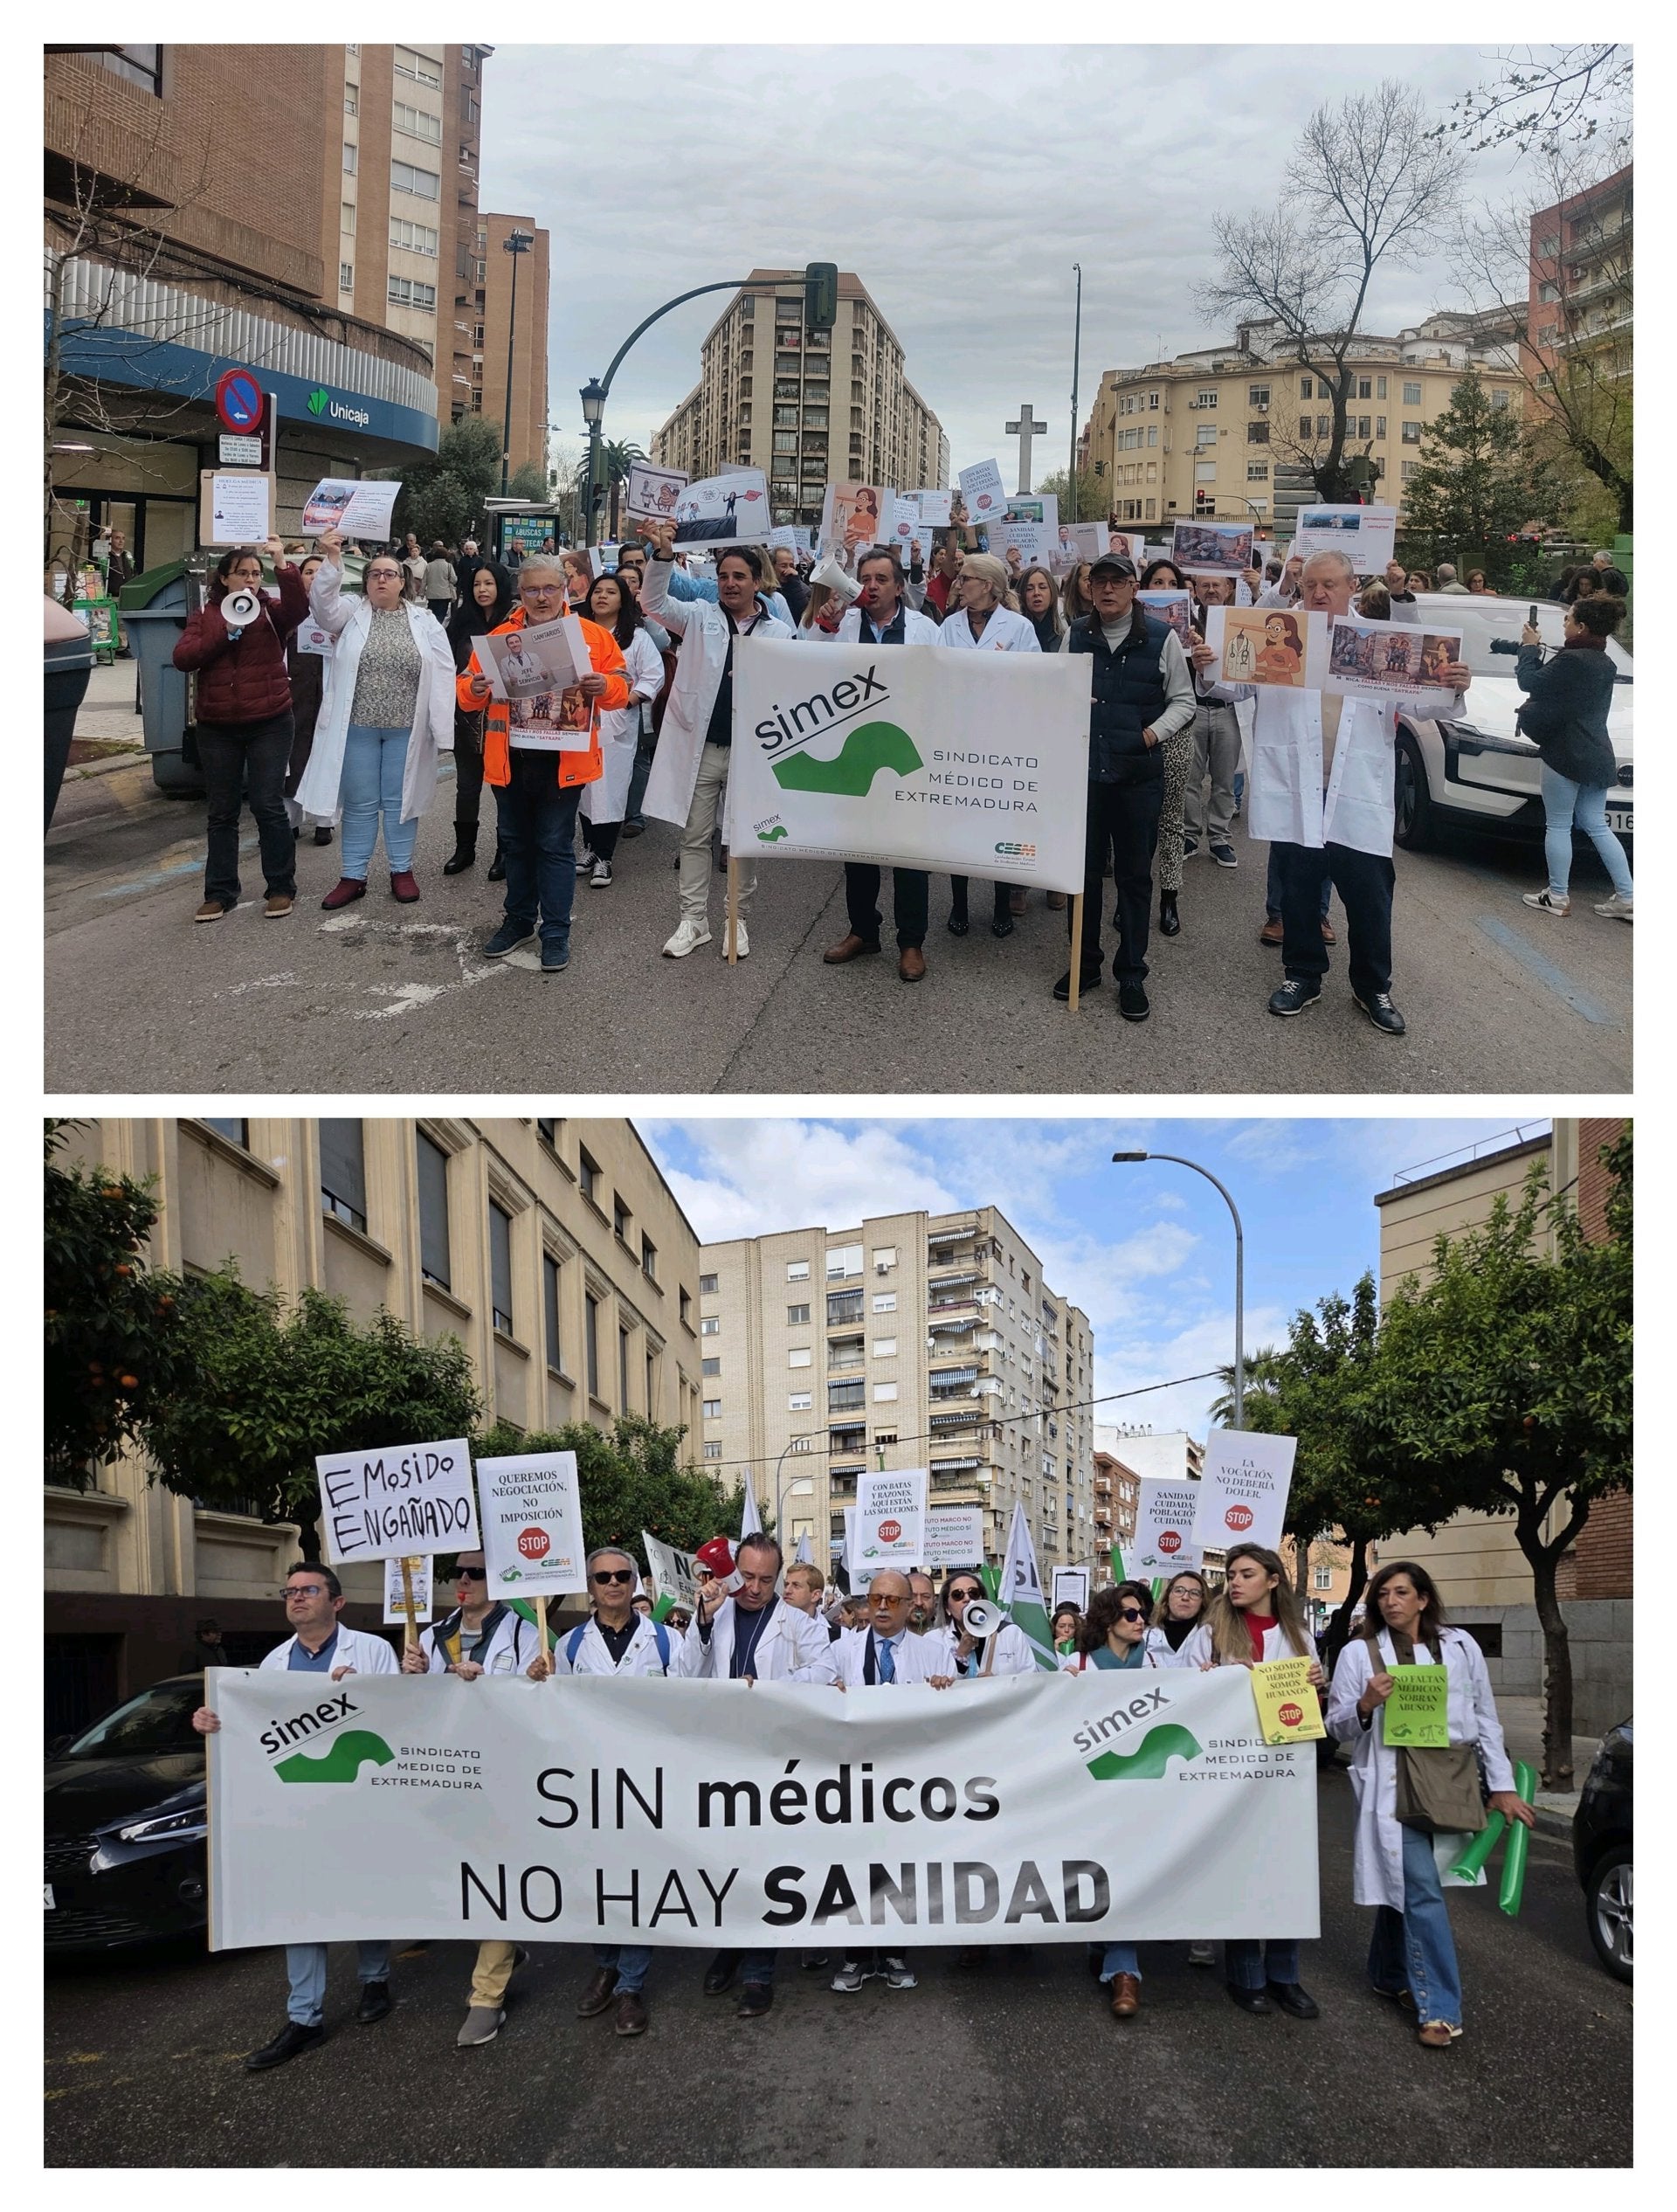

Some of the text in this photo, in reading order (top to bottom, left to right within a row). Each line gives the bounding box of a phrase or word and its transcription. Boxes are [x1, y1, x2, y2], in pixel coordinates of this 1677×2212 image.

[330, 401, 369, 428] Unicaja
[978, 498, 990, 507] STOP
[515, 528, 542, 536] ¿BUSCAS
[533, 627, 561, 641] SANITARIOS
[519, 676, 542, 685] SERVICIO
[755, 664, 887, 750] simex
[933, 750, 1039, 769] SINDICATO
[929, 771, 1039, 791] MÉDICO DE
[895, 790, 1038, 812] EXTREMADURA
[753, 813, 781, 832] simex
[839, 853, 889, 861] EXTREMADURA
[1242, 1459, 1254, 1468] LA
[499, 1470, 557, 1485] QUEREMOS
[1221, 1466, 1273, 1479] VOCACIÓN
[493, 1481, 568, 1497] NEGOCIACIÓN,
[889, 1482, 912, 1490] BATAS
[1215, 1476, 1275, 1490] NO DEBERÍA
[878, 1490, 912, 1499] RAZONES,
[1225, 1487, 1261, 1499] DOLER.
[522, 1498, 538, 1508] NO
[871, 1497, 912, 1508] AQUÍ ESTÁN
[500, 1508, 563, 1524] IMPOSICIÓN
[877, 1505, 919, 1515] SOLUCIONES
[1154, 1517, 1192, 1525] CUIDADA
[1226, 1511, 1252, 1524] STOP
[334, 1497, 470, 1556] ENGAÑADO
[879, 1527, 900, 1537] STOP
[520, 1536, 548, 1552] STOP
[1160, 1538, 1181, 1548] STOP
[1259, 1662, 1305, 1674] NO SOMOS
[1270, 1679, 1301, 1690] SOMOS
[1398, 1683, 1441, 1692] MÉDICOS
[1265, 1687, 1308, 1698] HUMANOS
[1399, 1704, 1436, 1712] ABUSOS
[1073, 1686, 1170, 1752] simex
[1280, 1709, 1301, 1721] STOP
[260, 1691, 358, 1754] simex
[400, 1747, 480, 1759] SINDICATO
[1205, 1752, 1294, 1764] MEDICO DE
[397, 1763, 482, 1774] MEDICO DE
[1179, 1769, 1295, 1780] EXTREMADURA
[371, 1777, 482, 1790] EXTREMADURA
[536, 1759, 1001, 1829] SIN médicos
[461, 1859, 1111, 1928] NO HAY SANIDAD
